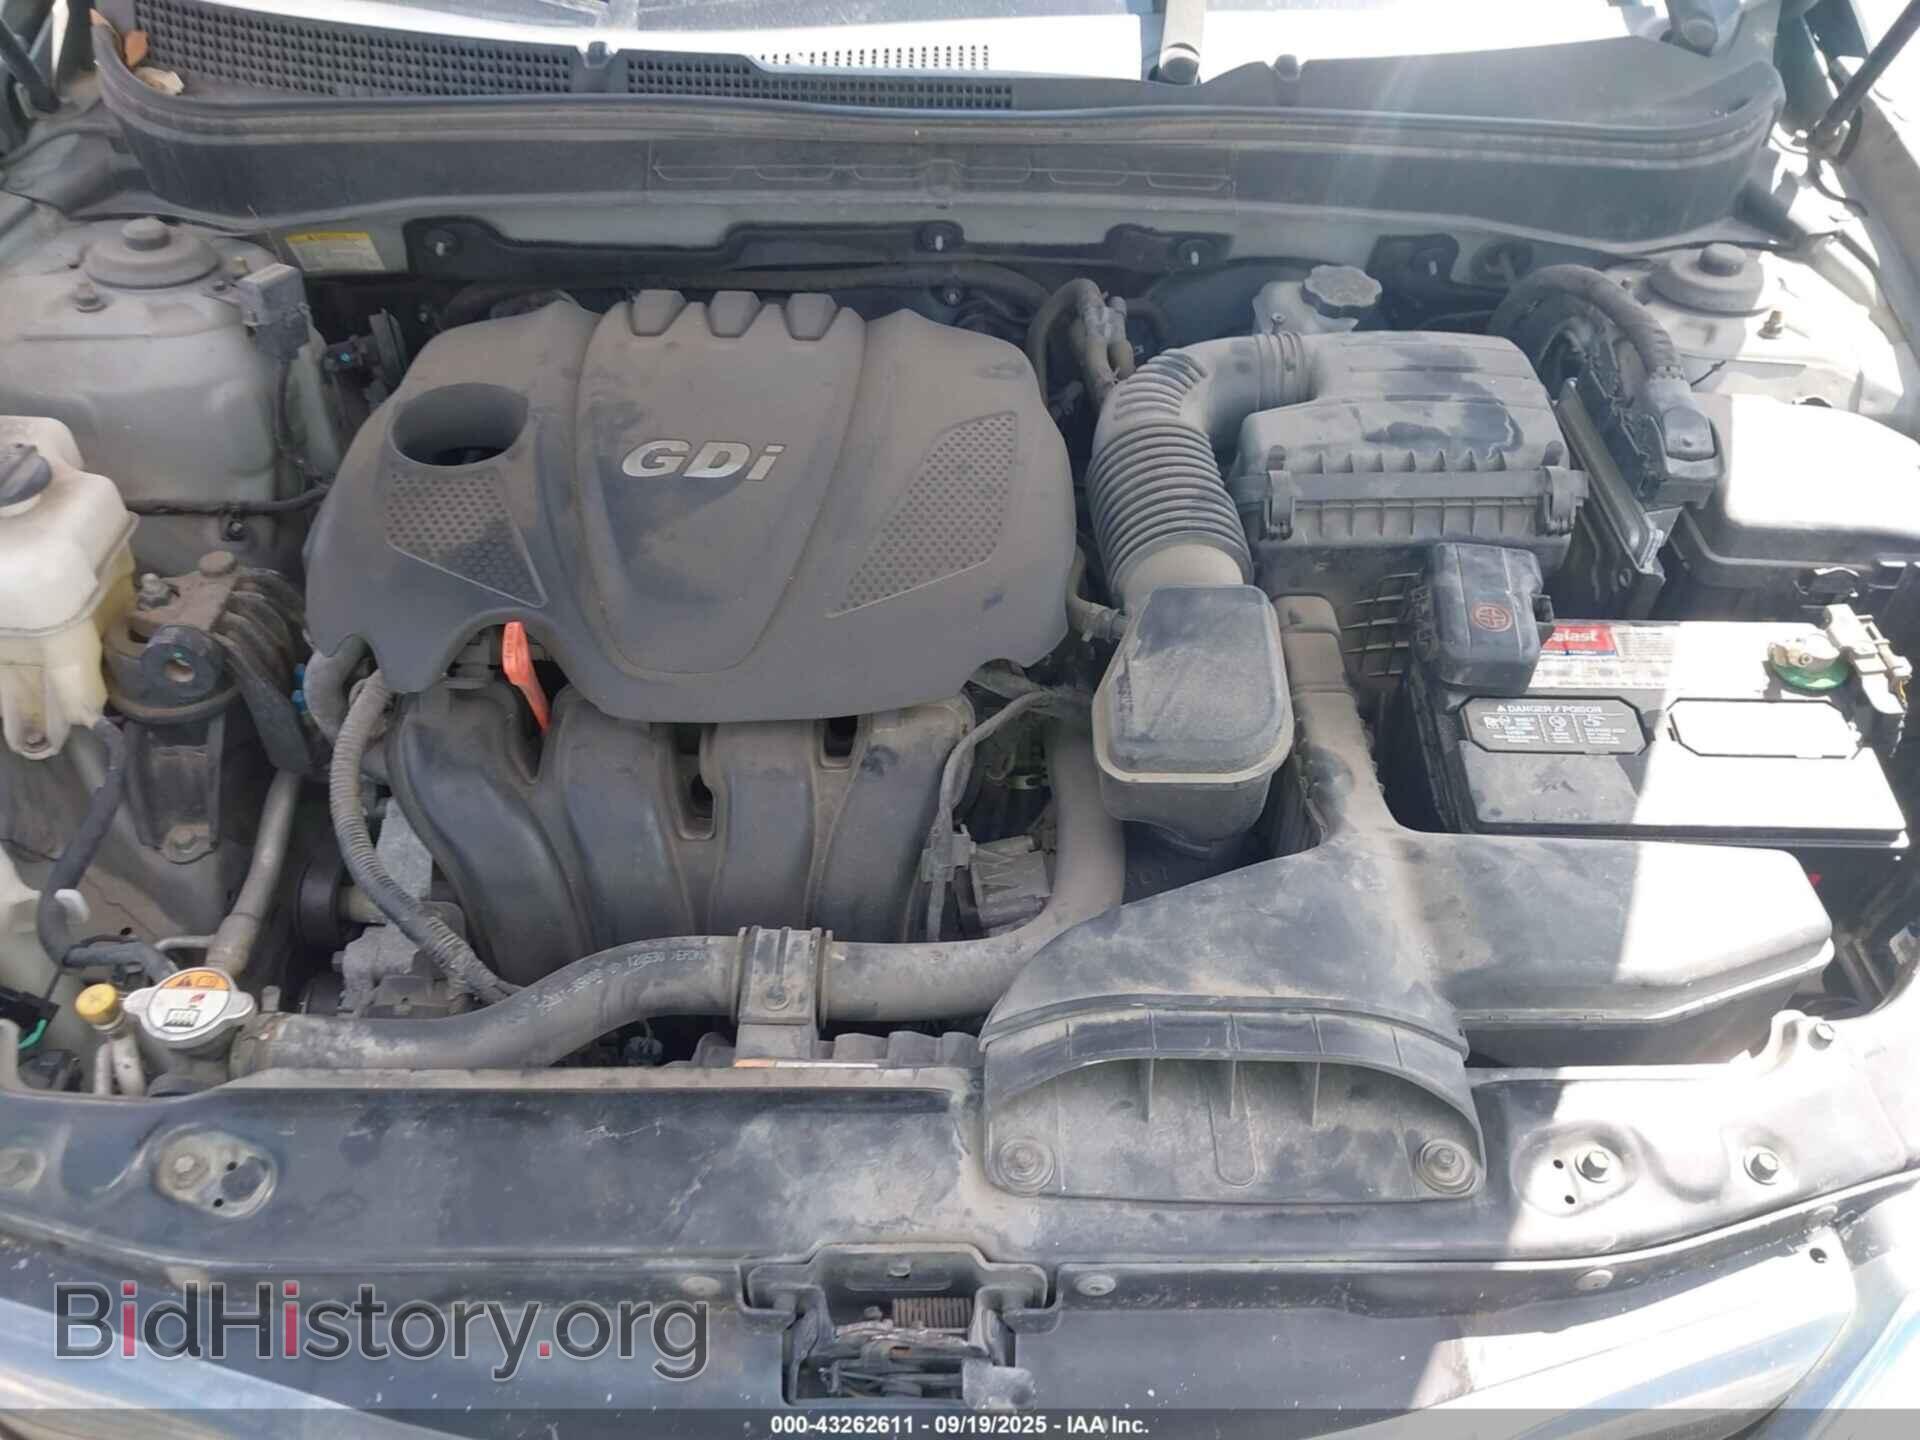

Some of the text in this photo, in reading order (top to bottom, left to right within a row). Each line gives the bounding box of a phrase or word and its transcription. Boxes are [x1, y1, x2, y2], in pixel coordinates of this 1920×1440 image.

[622, 440, 785, 481] GDi
[1549, 629, 1600, 642] alast
[1508, 705, 1551, 713] DANGER
[1563, 705, 1602, 713] POISON
